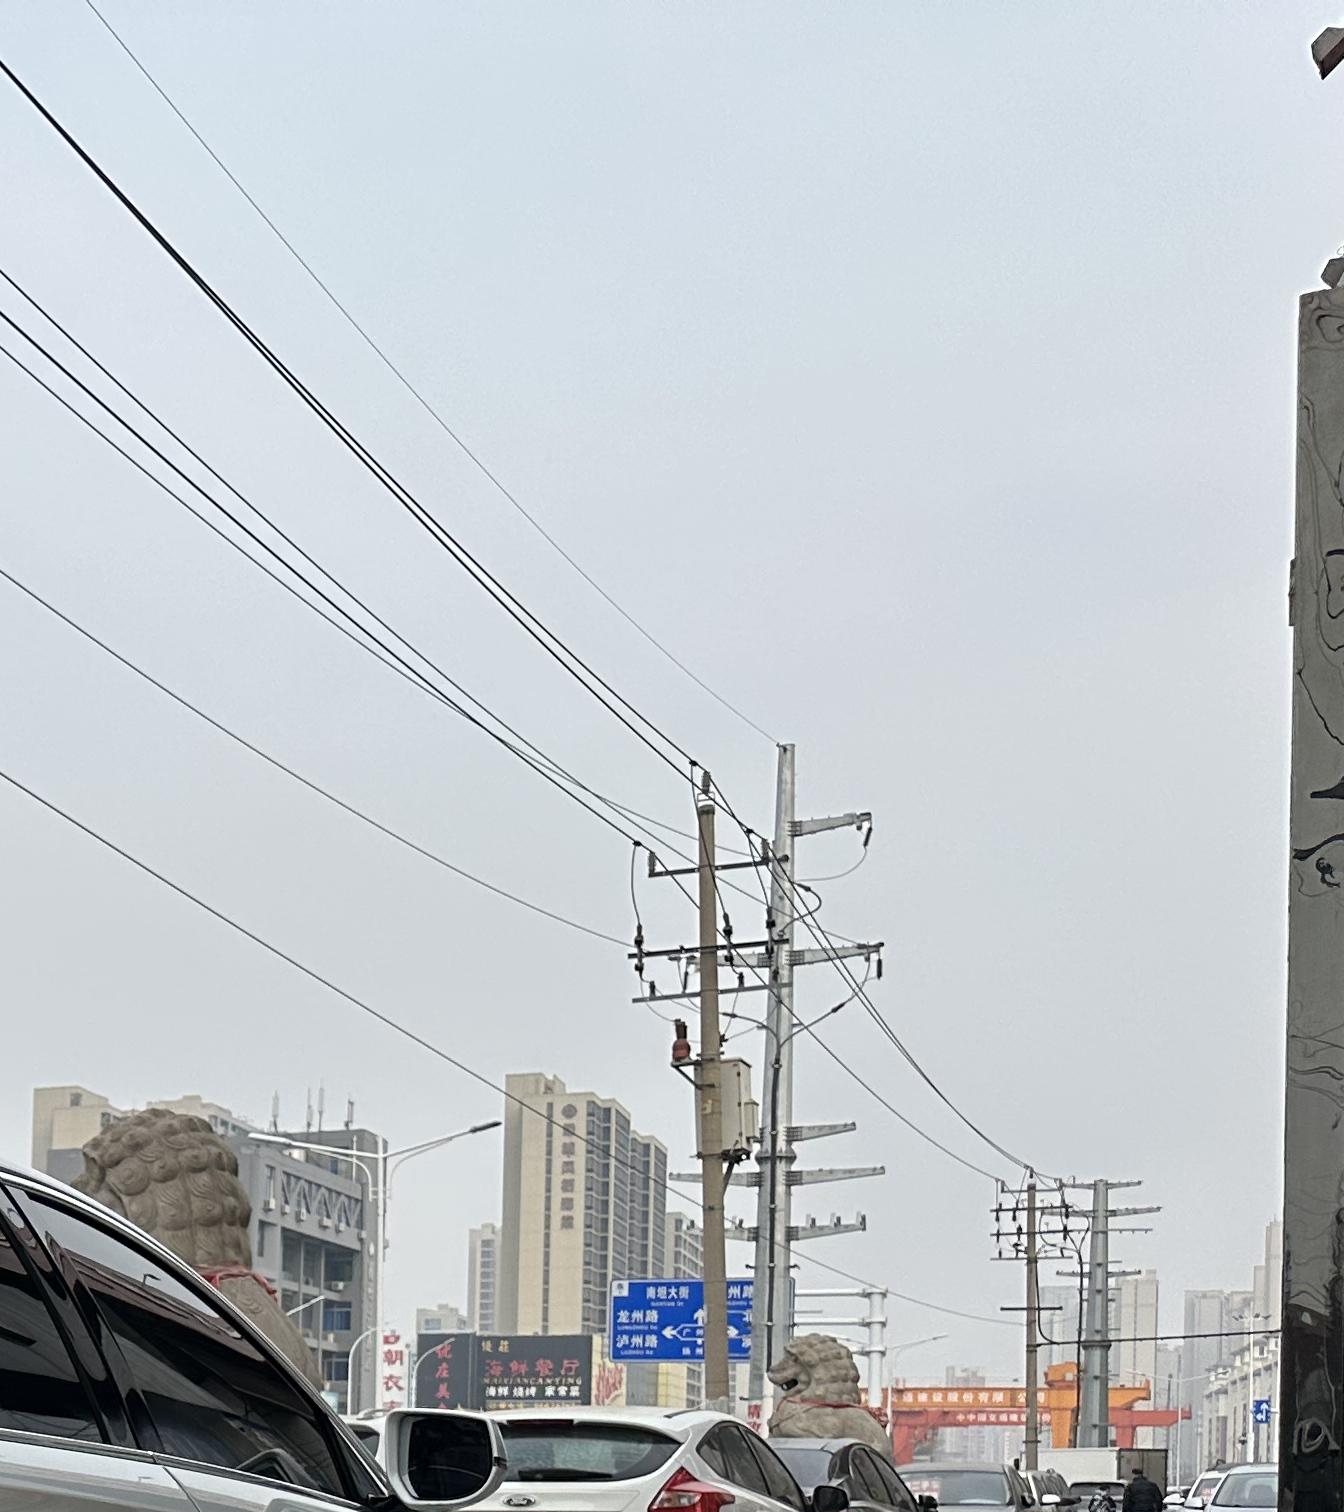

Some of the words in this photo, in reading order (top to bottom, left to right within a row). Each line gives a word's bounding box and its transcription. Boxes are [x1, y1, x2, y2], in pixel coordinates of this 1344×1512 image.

[727, 1284, 754, 1299] 州路
[485, 1358, 581, 1377] 海鲜餐厅
